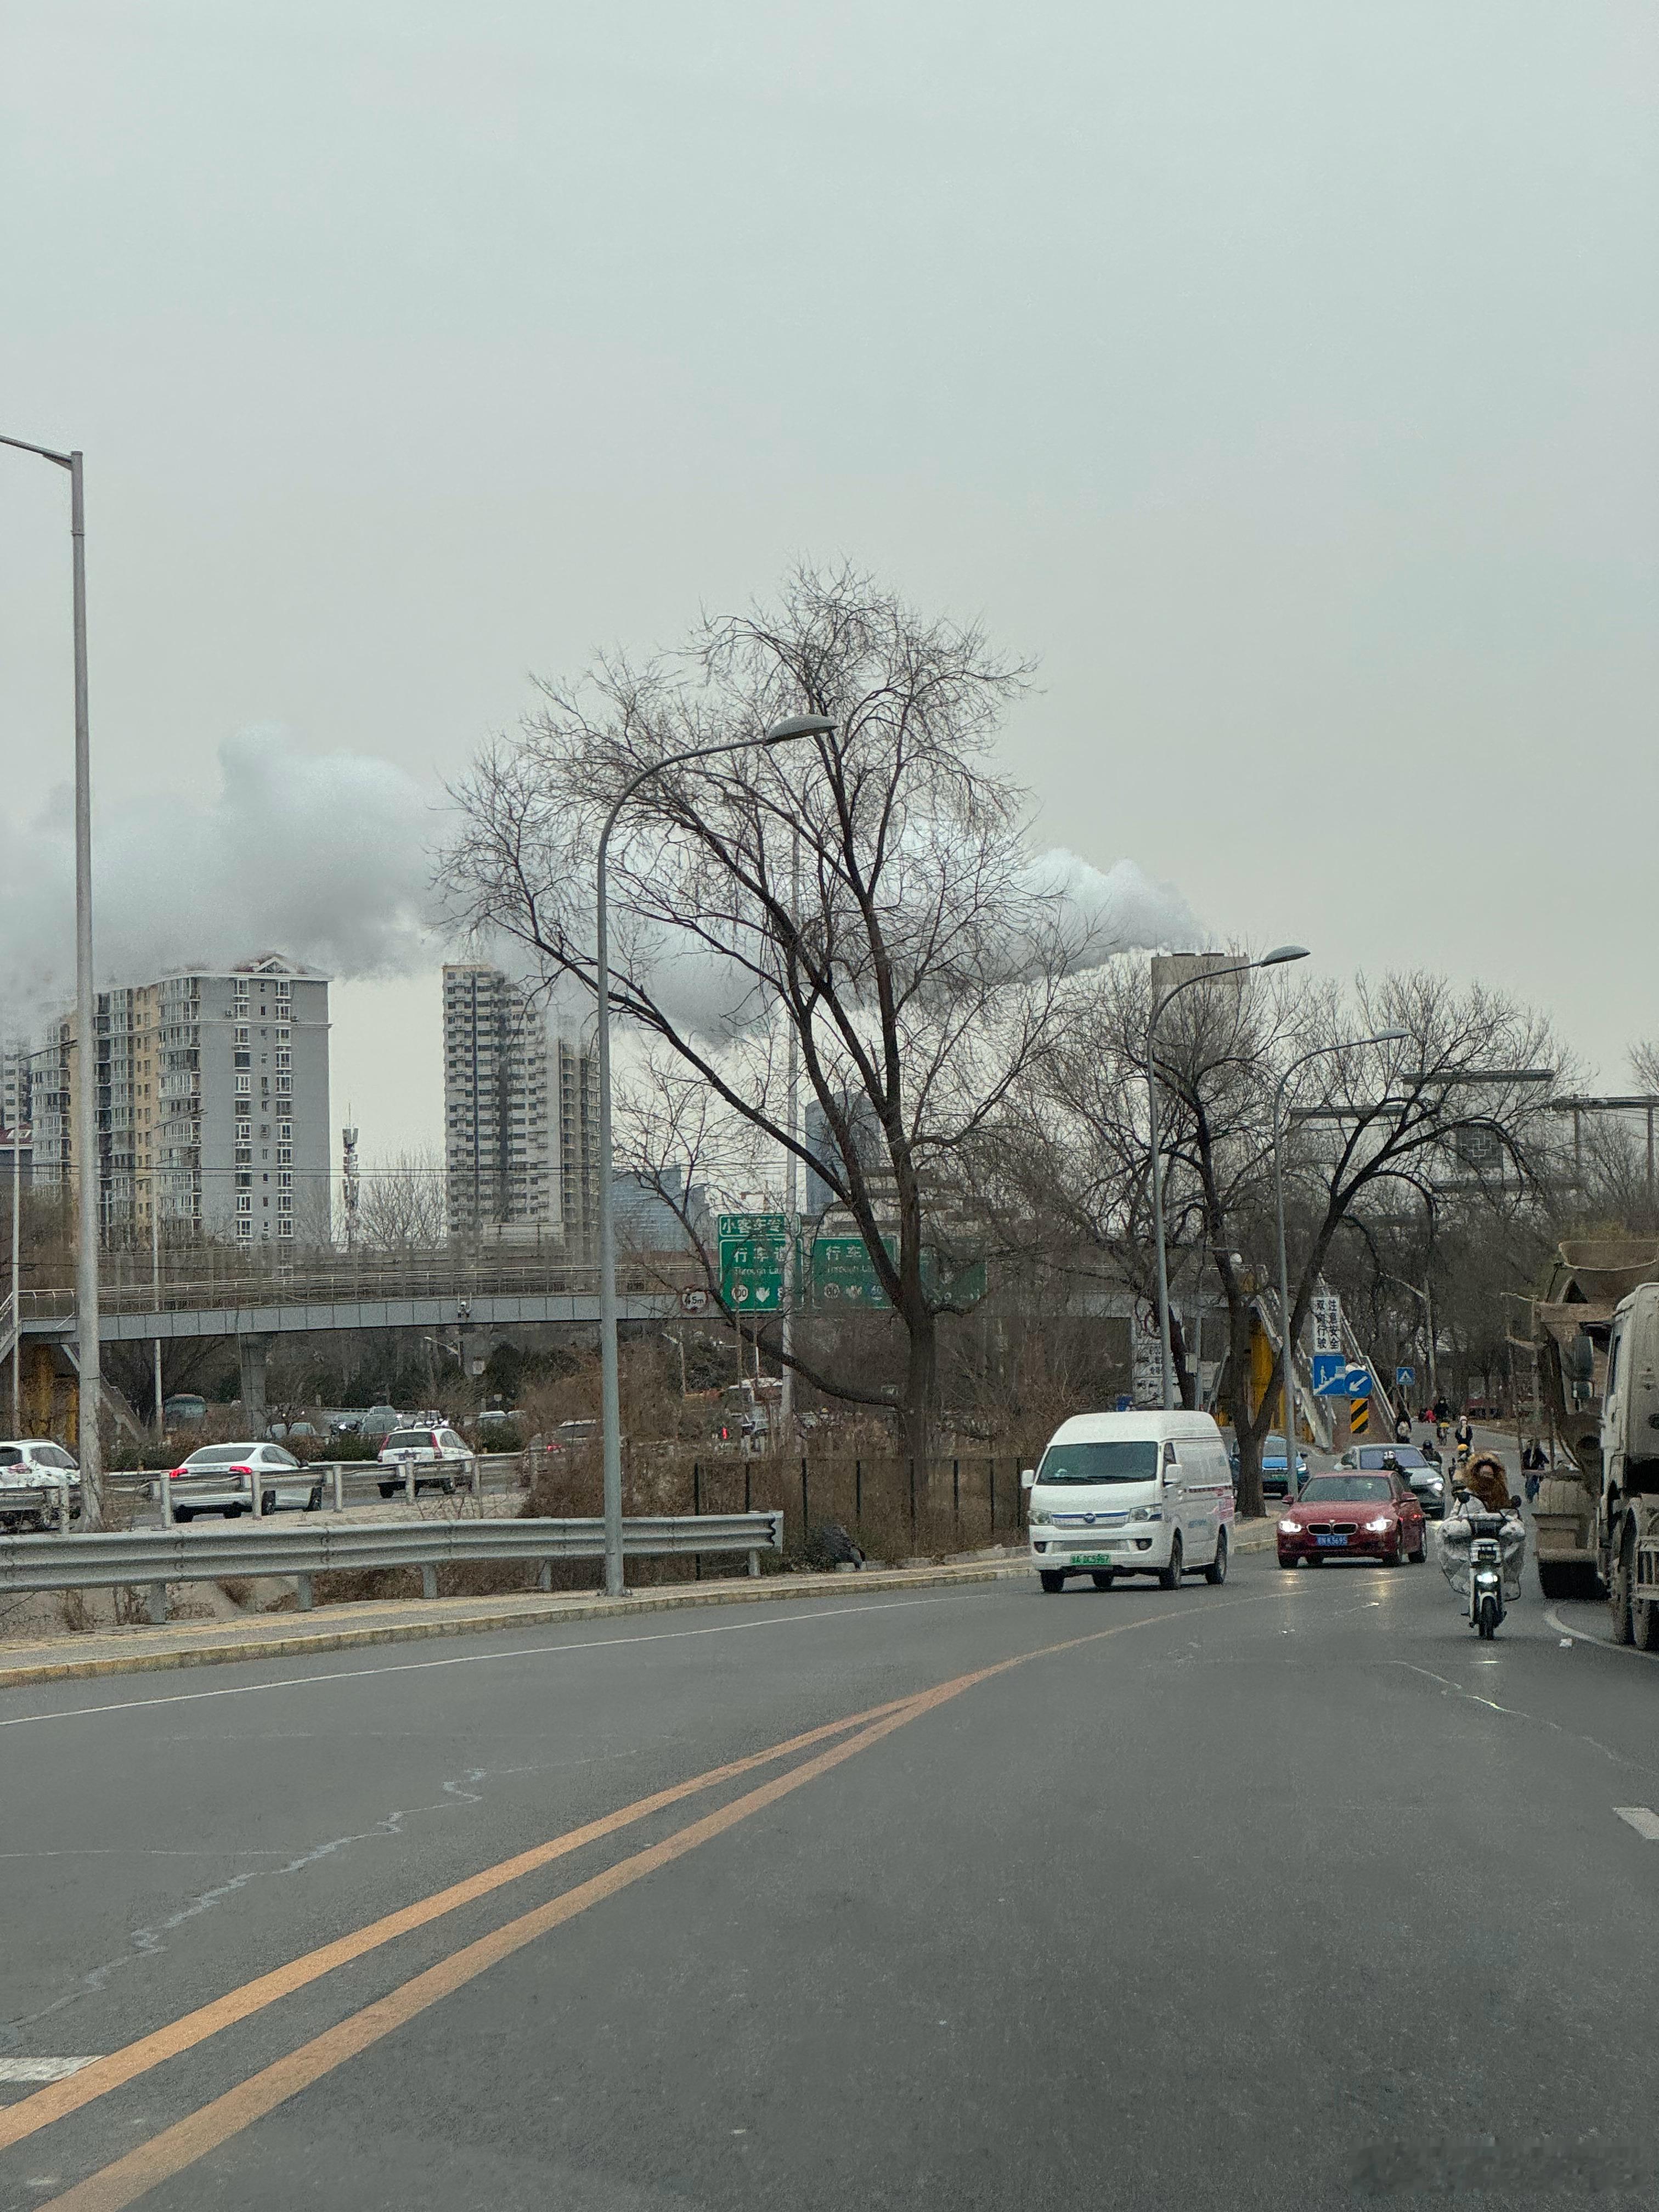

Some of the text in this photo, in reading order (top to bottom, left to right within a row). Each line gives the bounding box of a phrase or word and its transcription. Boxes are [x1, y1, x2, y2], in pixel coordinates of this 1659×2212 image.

[722, 1218, 797, 1234] 小客车专
[826, 1245, 871, 1261] 行车
[1328, 1299, 1339, 1349] 注意安全
